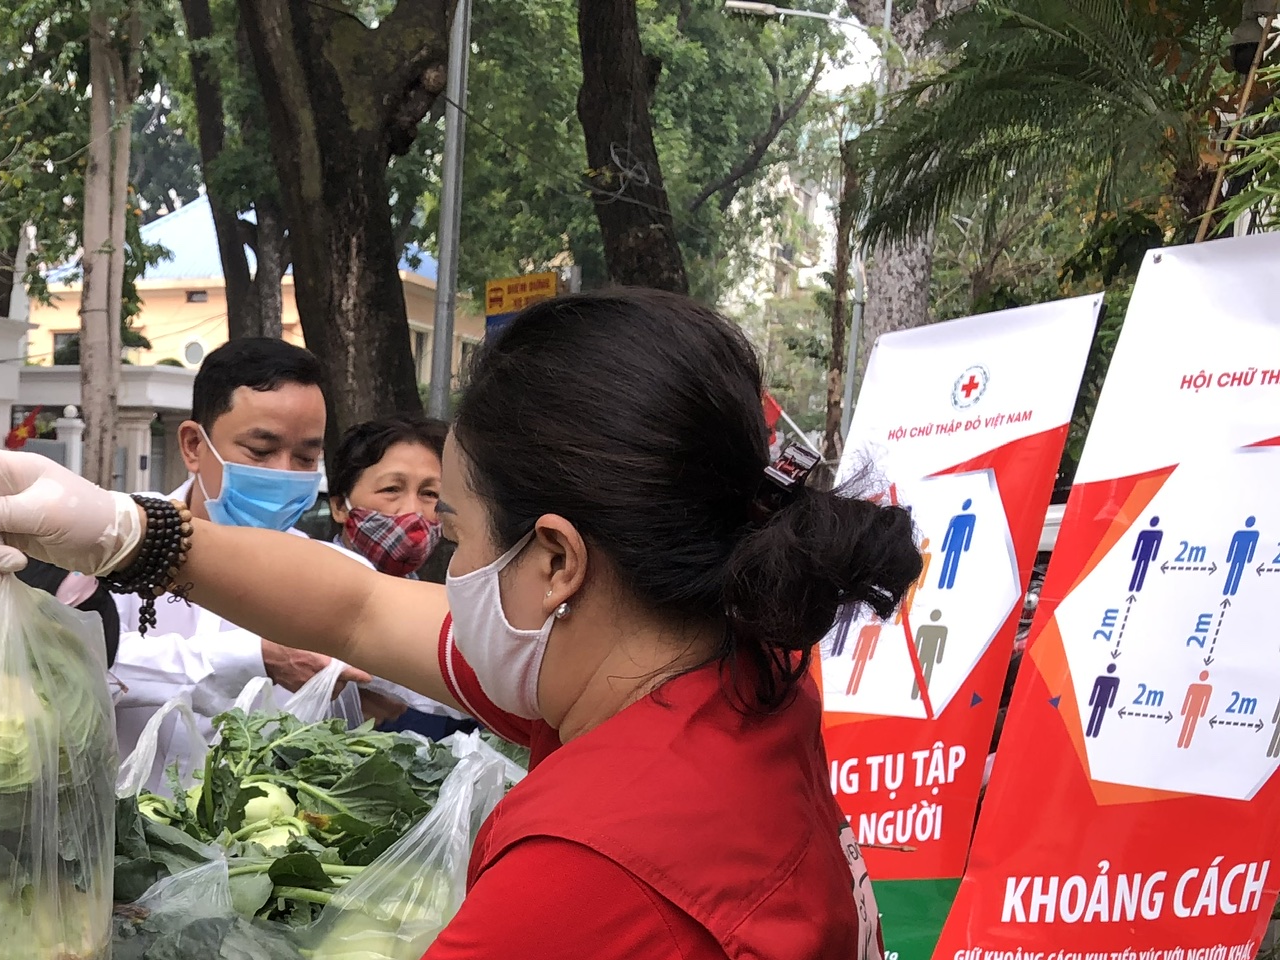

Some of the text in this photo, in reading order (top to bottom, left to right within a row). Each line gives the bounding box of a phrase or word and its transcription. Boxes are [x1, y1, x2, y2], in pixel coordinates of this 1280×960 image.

[1180, 367, 1280, 393] HỘI CHỮ TH
[887, 410, 1033, 442] HỘI CHỮ THẬP ĐỎ VIỆT NAM
[1174, 540, 1207, 563] 2m
[1093, 608, 1119, 642] 2m
[1186, 613, 1213, 648] 2m
[1132, 683, 1165, 707] 2m
[1225, 691, 1258, 715] 2m
[866, 753, 905, 800] TỤ
[912, 740, 966, 796] TẬP
[858, 799, 943, 845] NGƯỜI
[1000, 856, 1271, 923] KHOẢNG CÁCH
